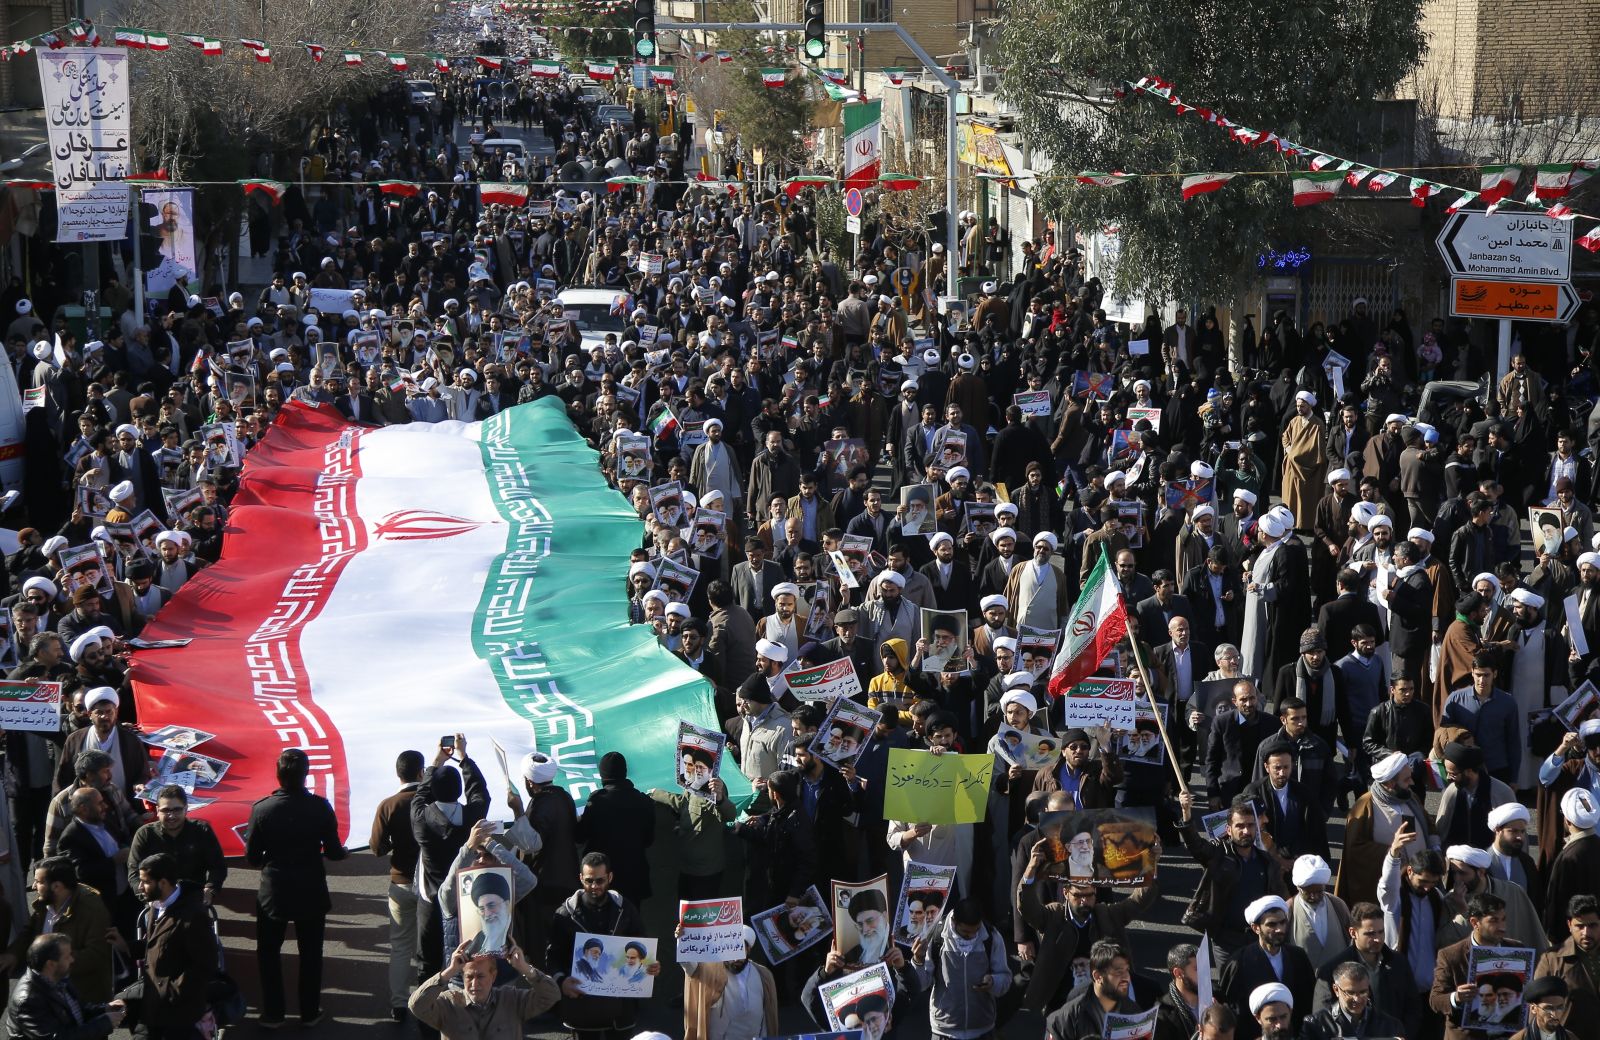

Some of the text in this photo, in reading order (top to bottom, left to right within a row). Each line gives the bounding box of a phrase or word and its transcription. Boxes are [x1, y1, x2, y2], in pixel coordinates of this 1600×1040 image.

[55, 131, 128, 161] عرفان
[1507, 220, 1548, 231] جانبازان
[1488, 236, 1512, 249] امین
[1516, 238, 1548, 248] محمد
[1468, 252, 1522, 263] Janbazan Sq.
[1468, 264, 1561, 276] Mohammad Amin Blvd.
[1510, 286, 1540, 297] موزه
[1496, 300, 1530, 312] مطهر
[1532, 304, 1554, 314] حرم
[1120, 716, 1132, 724] نوکر
[891, 764, 915, 788] نفوذ
[956, 762, 992, 792] تلگرام
[702, 934, 712, 942] قوه
[680, 944, 709, 954] آمریکایی
